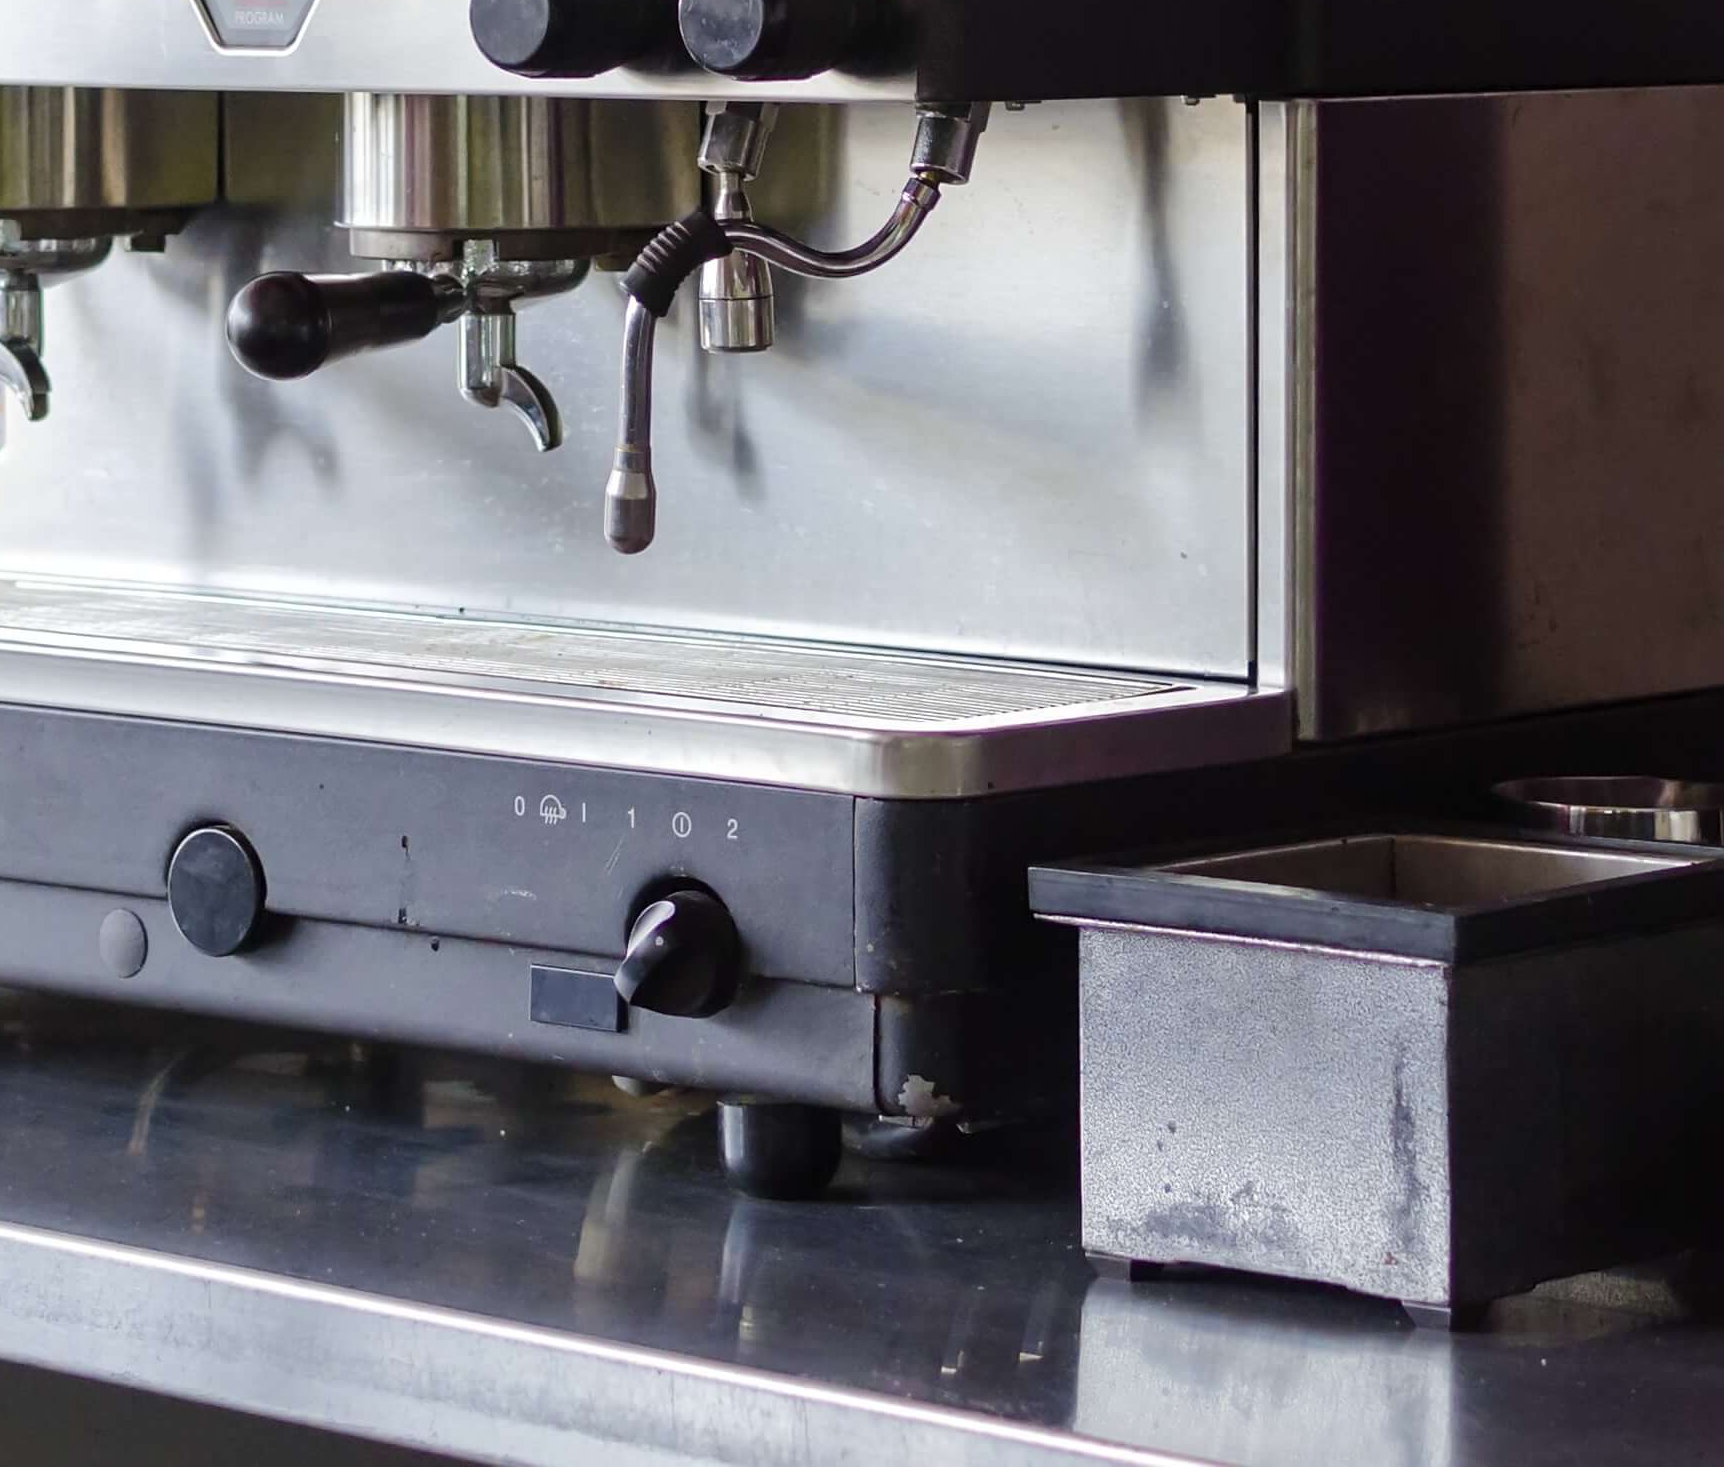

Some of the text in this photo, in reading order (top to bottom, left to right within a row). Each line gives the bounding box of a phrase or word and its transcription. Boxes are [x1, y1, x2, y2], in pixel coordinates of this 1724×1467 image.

[234, 10, 285, 26] PROGRAM
[513, 795, 526, 817] 0
[627, 806, 636, 829] 1
[726, 818, 739, 840] 2
